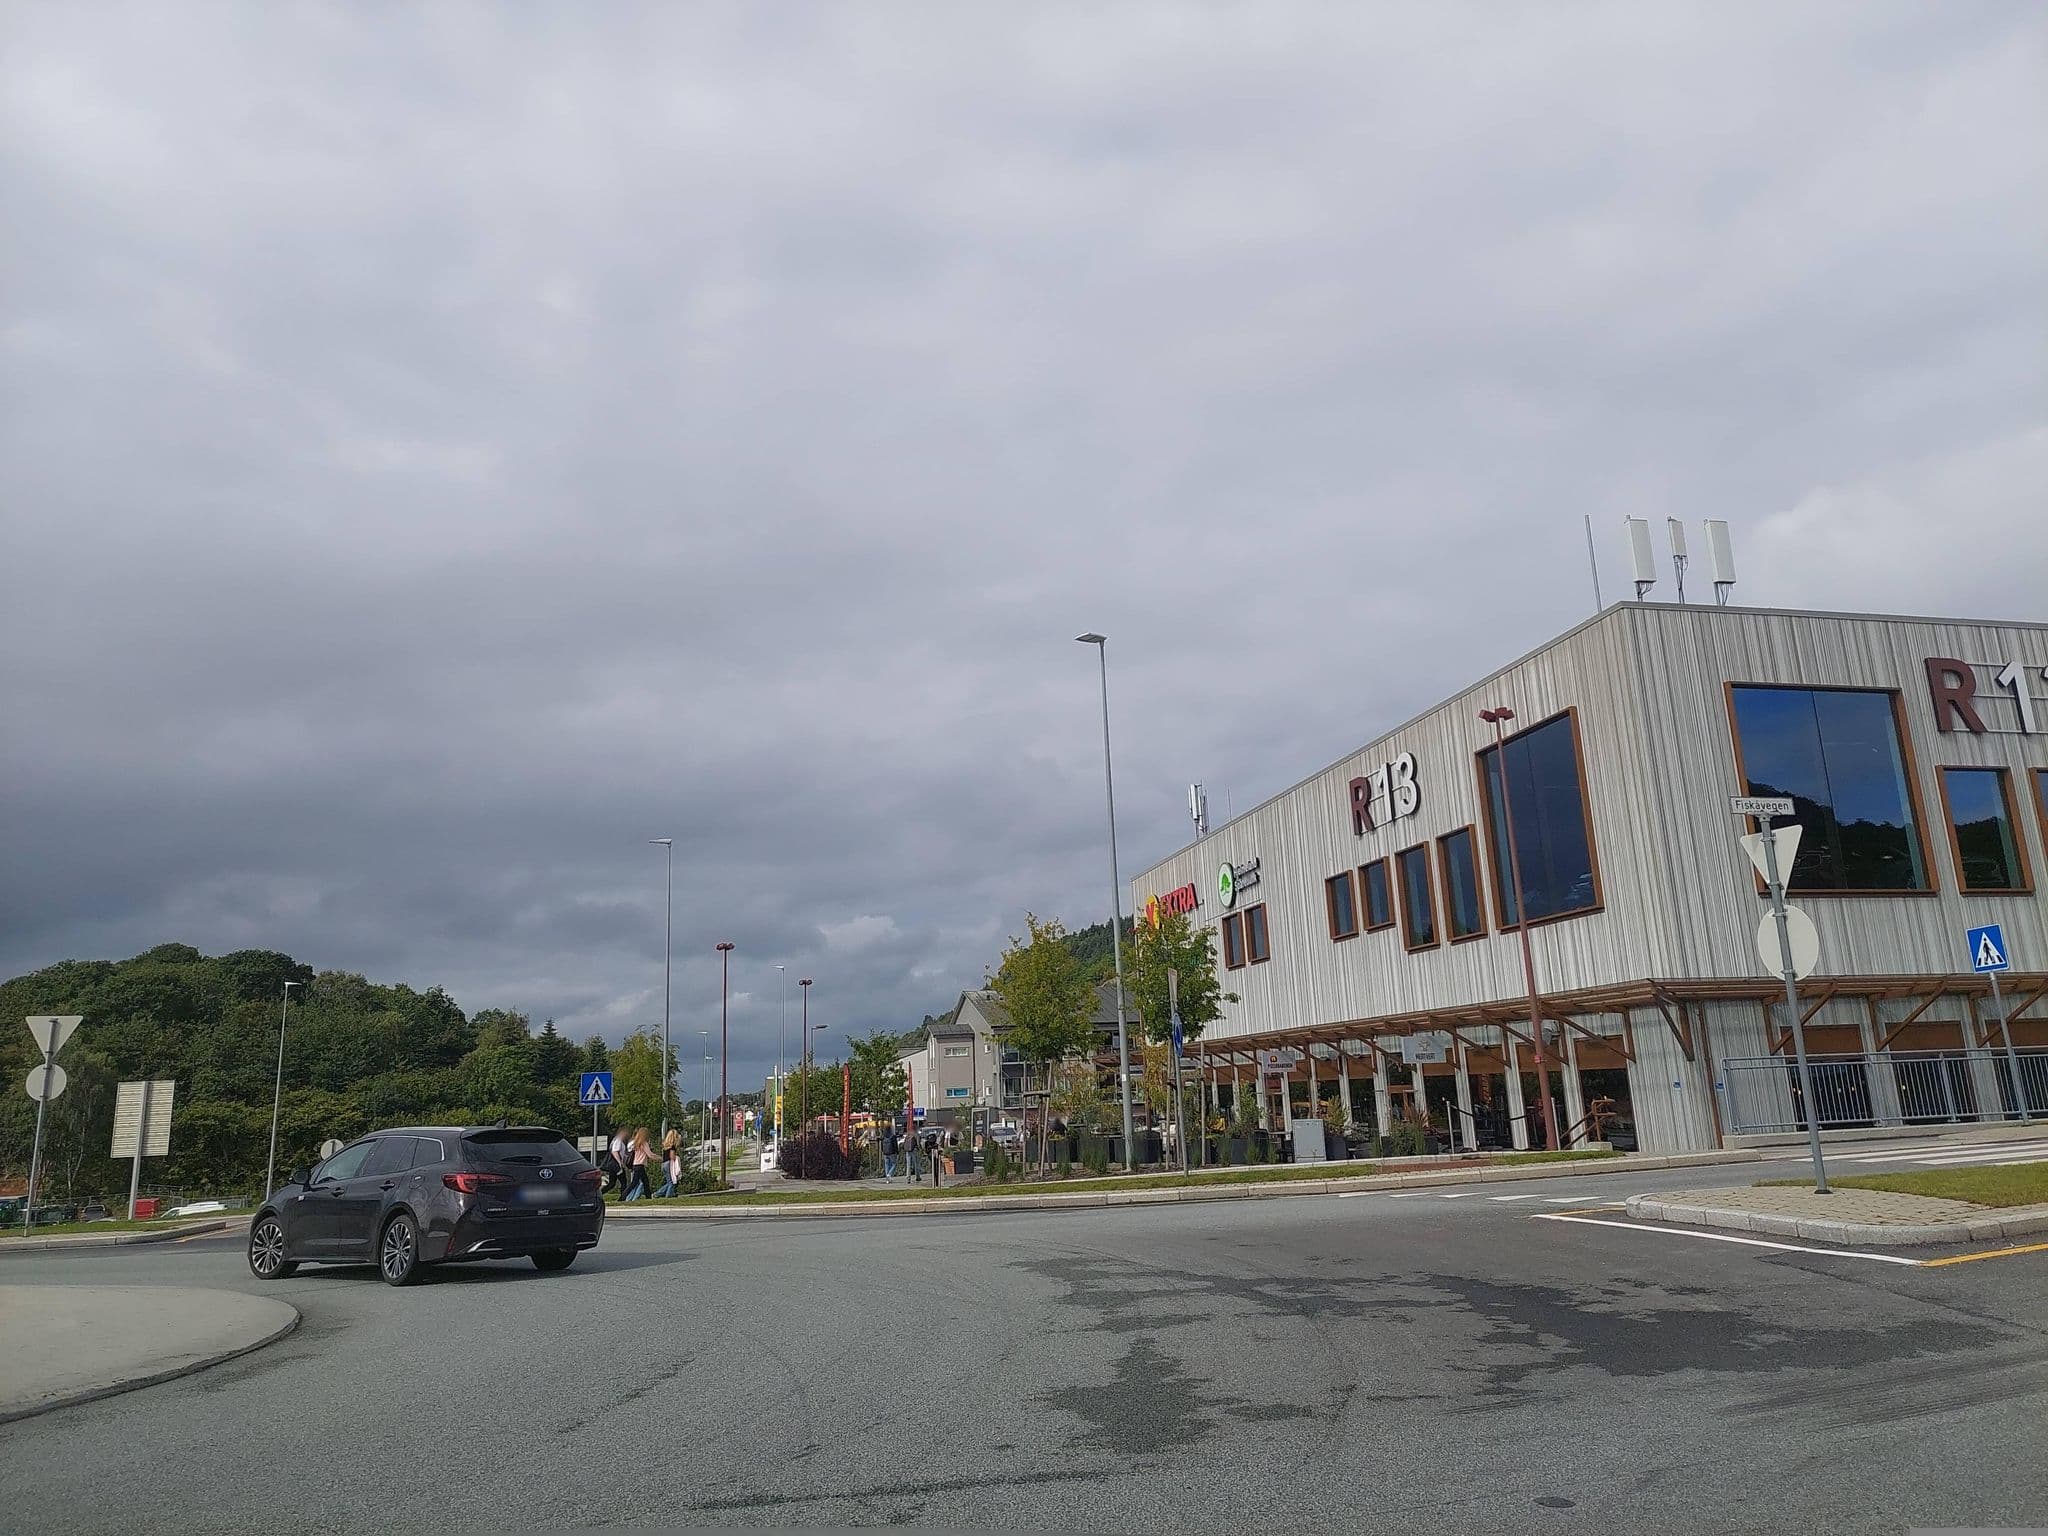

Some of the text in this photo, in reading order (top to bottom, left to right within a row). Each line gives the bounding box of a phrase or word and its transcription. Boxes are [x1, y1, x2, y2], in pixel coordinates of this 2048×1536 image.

[1924, 656, 2048, 735] R1
[1350, 751, 1421, 836] R13
[1160, 882, 1199, 919] EXTRA
